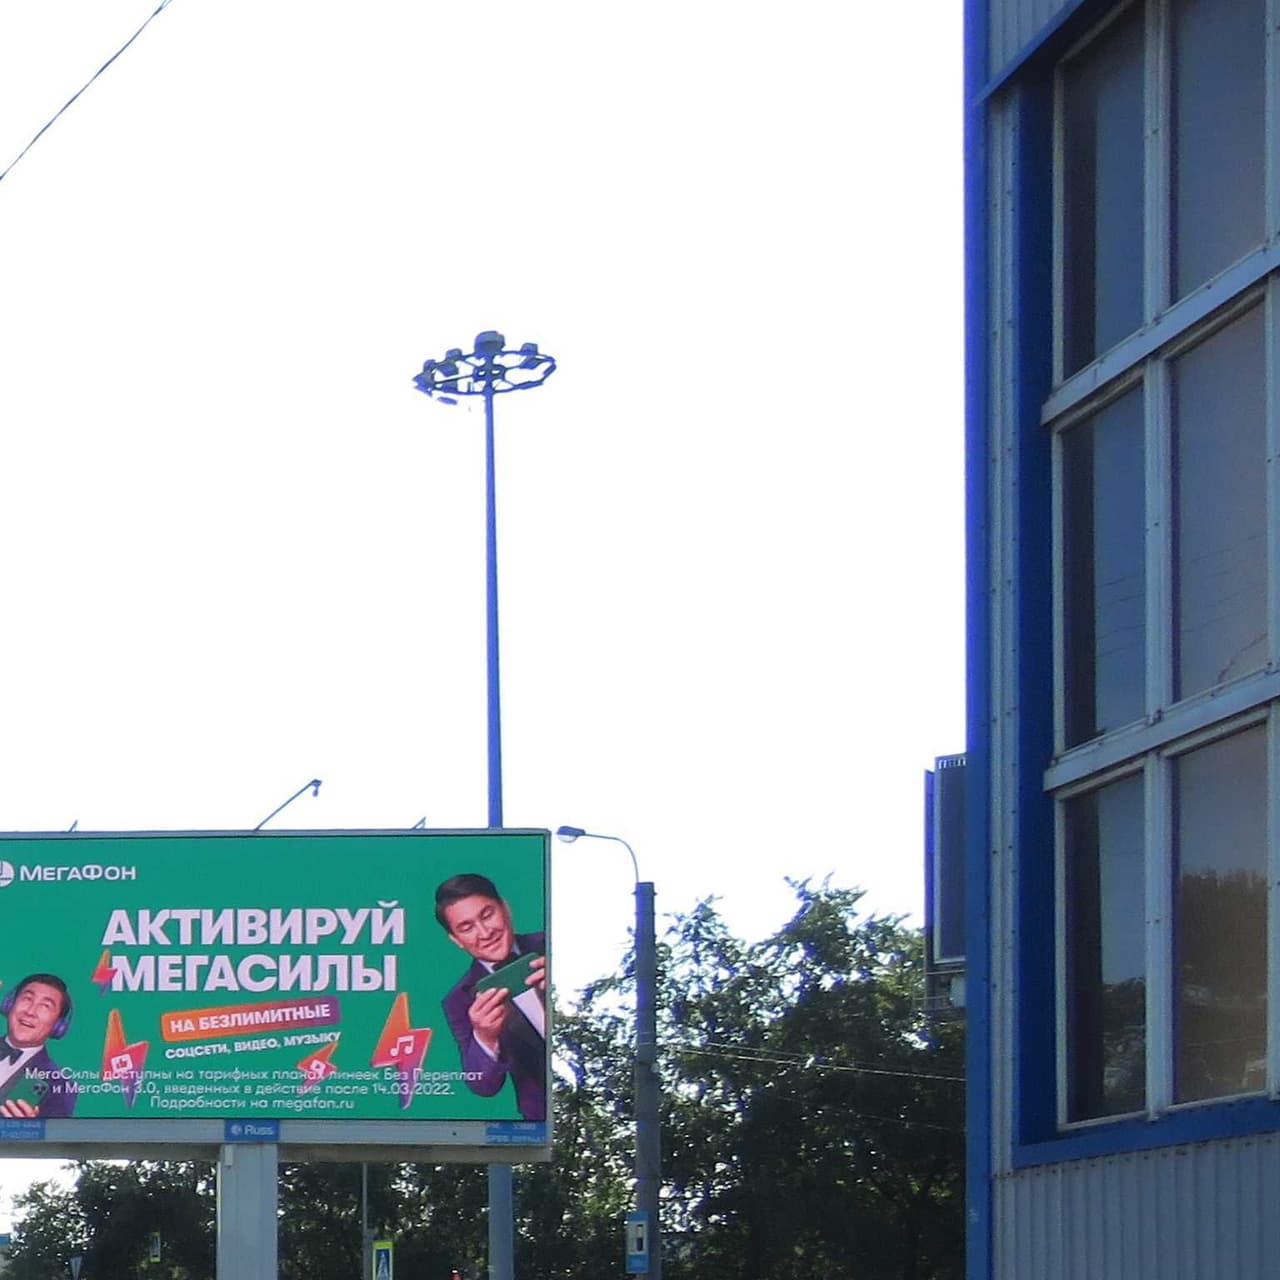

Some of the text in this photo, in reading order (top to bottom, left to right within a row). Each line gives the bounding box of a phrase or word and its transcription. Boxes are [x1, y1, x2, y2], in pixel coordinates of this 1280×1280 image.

[101, 900, 405, 946] АКТИВИРУЙ
[110, 953, 397, 993] МЕГАСИЛЫ
[170, 1004, 332, 1033] НА БЕЗЛИМИТНЫЕ
[164, 1032, 342, 1060] СОЦСЕТИ, ВИДЕО, МУЗЫКУ
[25, 1067, 484, 1084] МегаСилы доступны на тарифных планах линеек Без Переплат
[52, 1081, 455, 1096] и МегаФон 3.0, введенных в действие после 14.03.2022.
[151, 1097, 355, 1111] Подробности на megafon.ru
[244, 1125, 273, 1136] Russ
